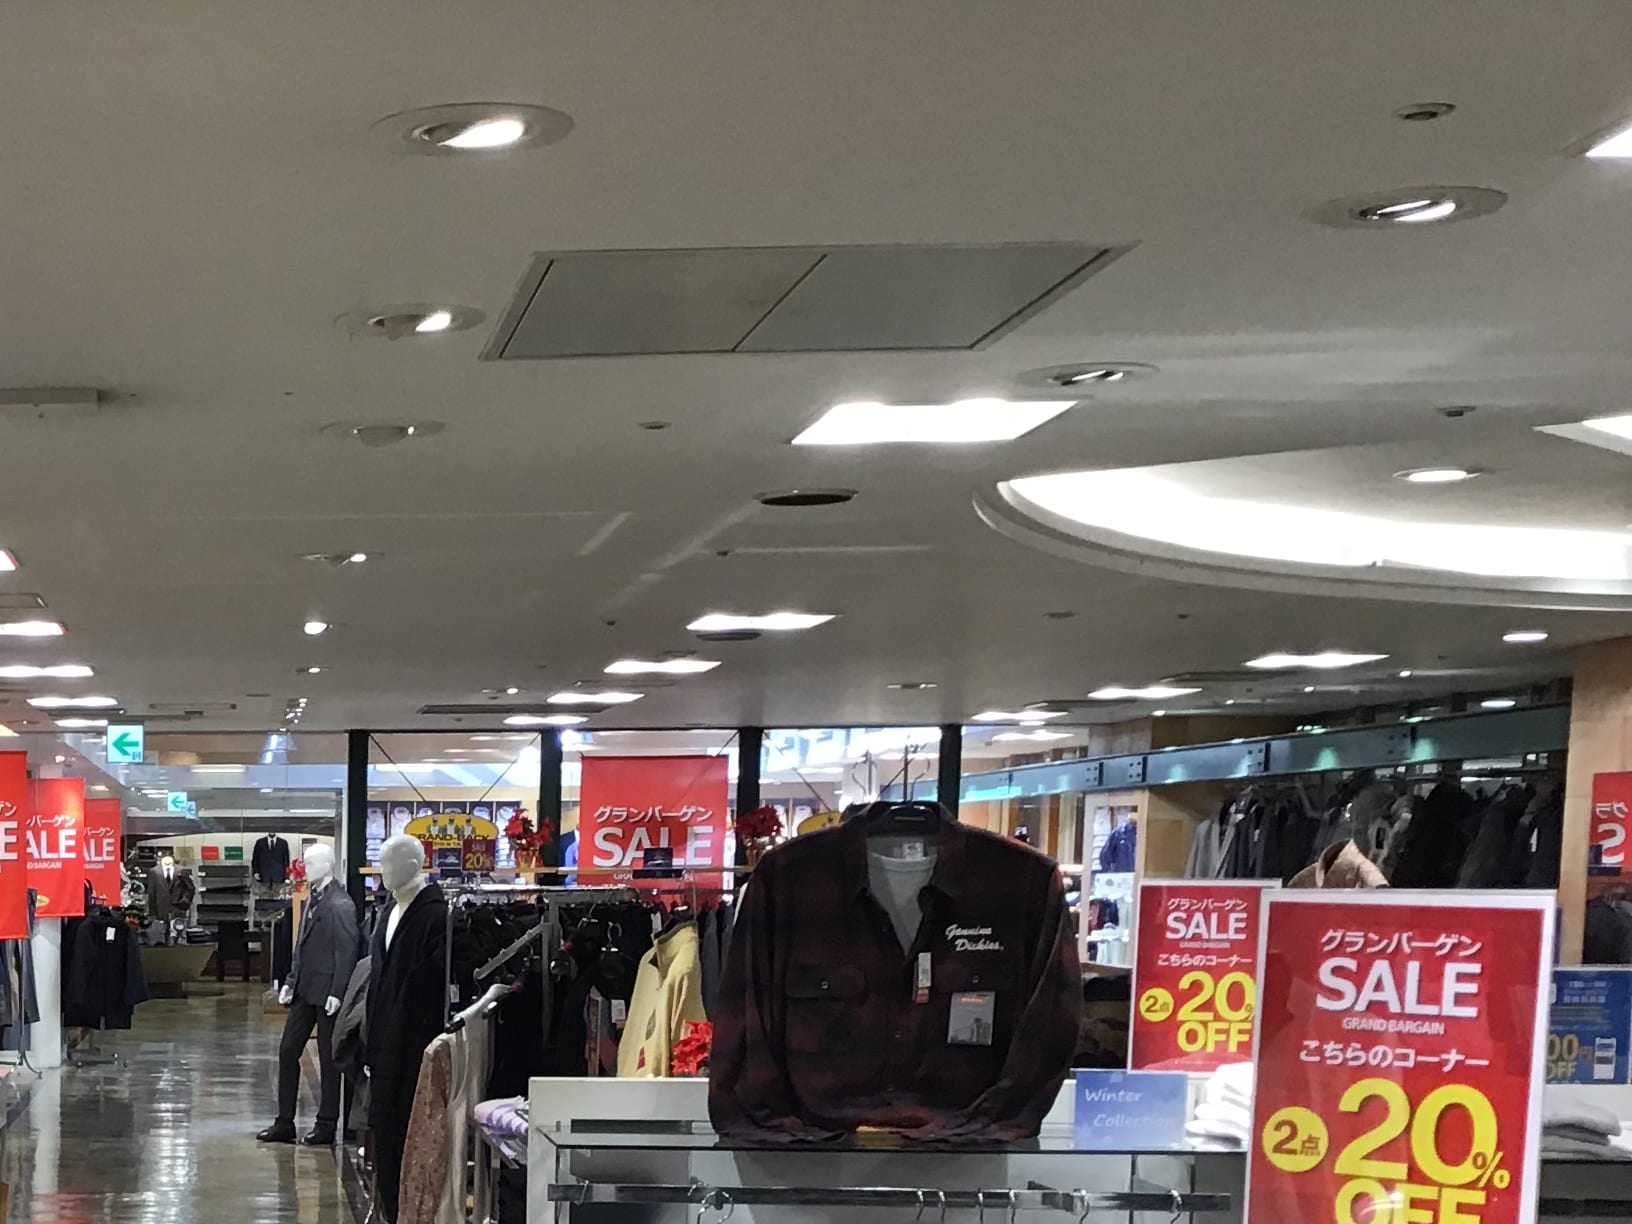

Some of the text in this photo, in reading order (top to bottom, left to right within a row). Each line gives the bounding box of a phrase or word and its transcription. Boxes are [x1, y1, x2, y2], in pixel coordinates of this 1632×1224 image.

[593, 805, 713, 824] グランバーゲン
[592, 825, 714, 868] SALE
[1167, 897, 1248, 911] グランバーゲン
[1165, 911, 1248, 940] SALE
[1320, 928, 1483, 957] グランバーゲン
[1157, 953, 1253, 967] こちらのコーナー
[1315, 956, 1483, 1018] SALE
[1177, 1020, 1252, 1053] OFF
[1342, 1016, 1445, 1036] GRAND BARGAIN
[1299, 1039, 1490, 1073] こちらのコーナー
[1084, 1087, 1145, 1103] Winter
[1334, 1077, 1511, 1190] 20%
